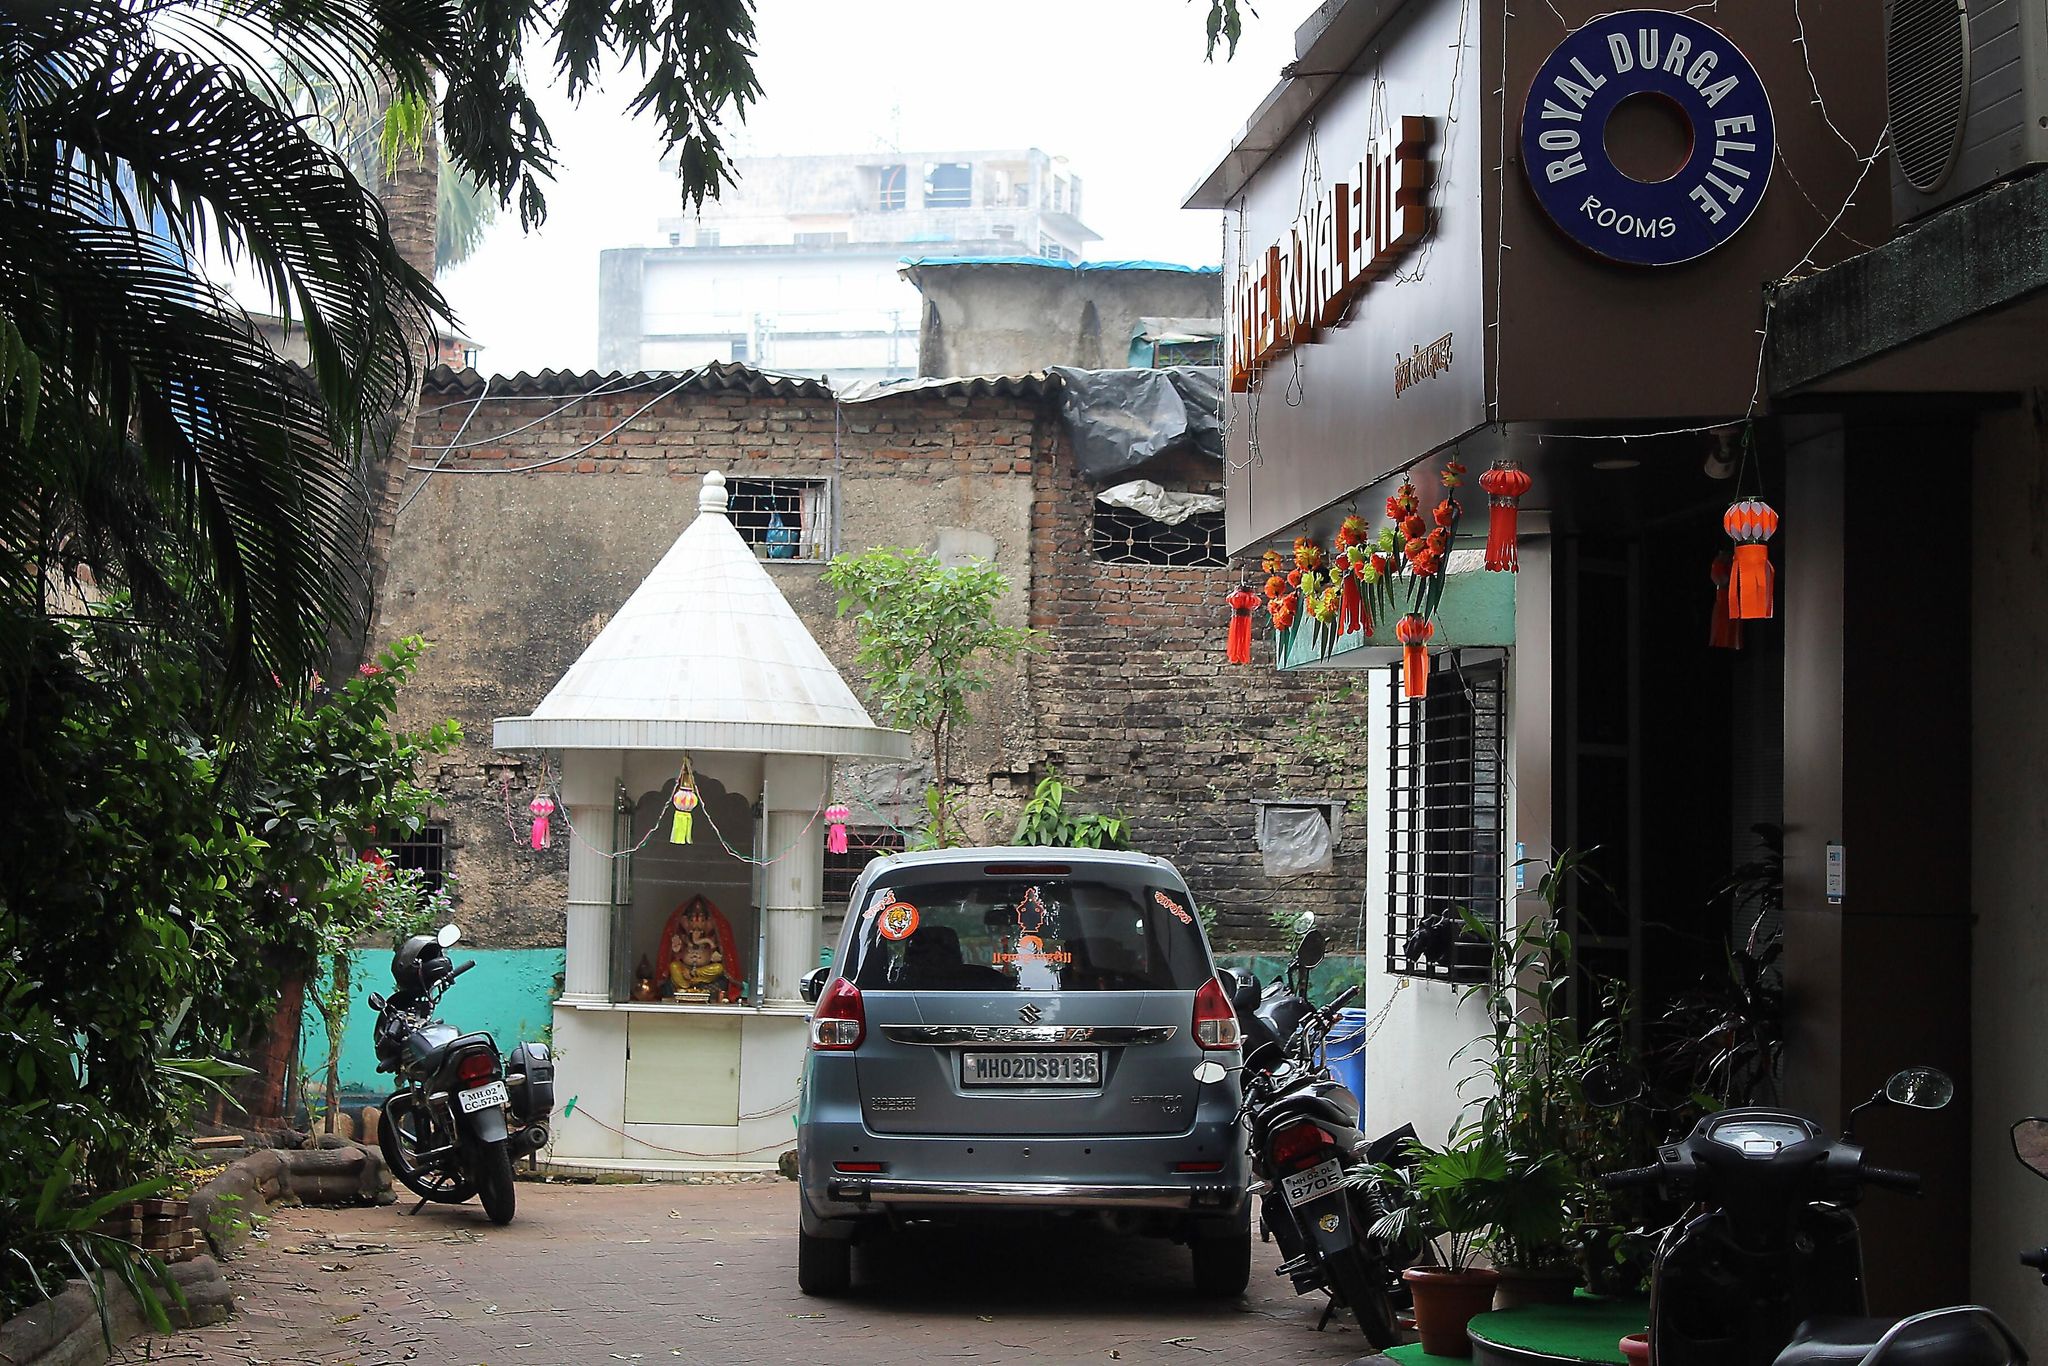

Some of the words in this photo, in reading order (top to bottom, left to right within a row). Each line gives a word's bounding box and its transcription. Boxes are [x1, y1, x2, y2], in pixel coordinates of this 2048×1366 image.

[1538, 56, 1608, 184] ROYAL
[1606, 28, 1740, 109] DURGA
[1688, 114, 1757, 225] ELITE
[1579, 194, 1677, 239] ROOMS
[1230, 247, 1276, 378] HOTEL
[1277, 185, 1344, 345] ROYAL
[1348, 115, 1406, 284] ELITE
[976, 1057, 1097, 1080] MH02DS8136
[464, 1095, 505, 1111] CC.5794
[468, 1088, 497, 1101] MH.02
[1291, 1173, 1340, 1199] 8705
[1292, 1176, 1306, 1187] MH
[1307, 1171, 1320, 1181] 02
